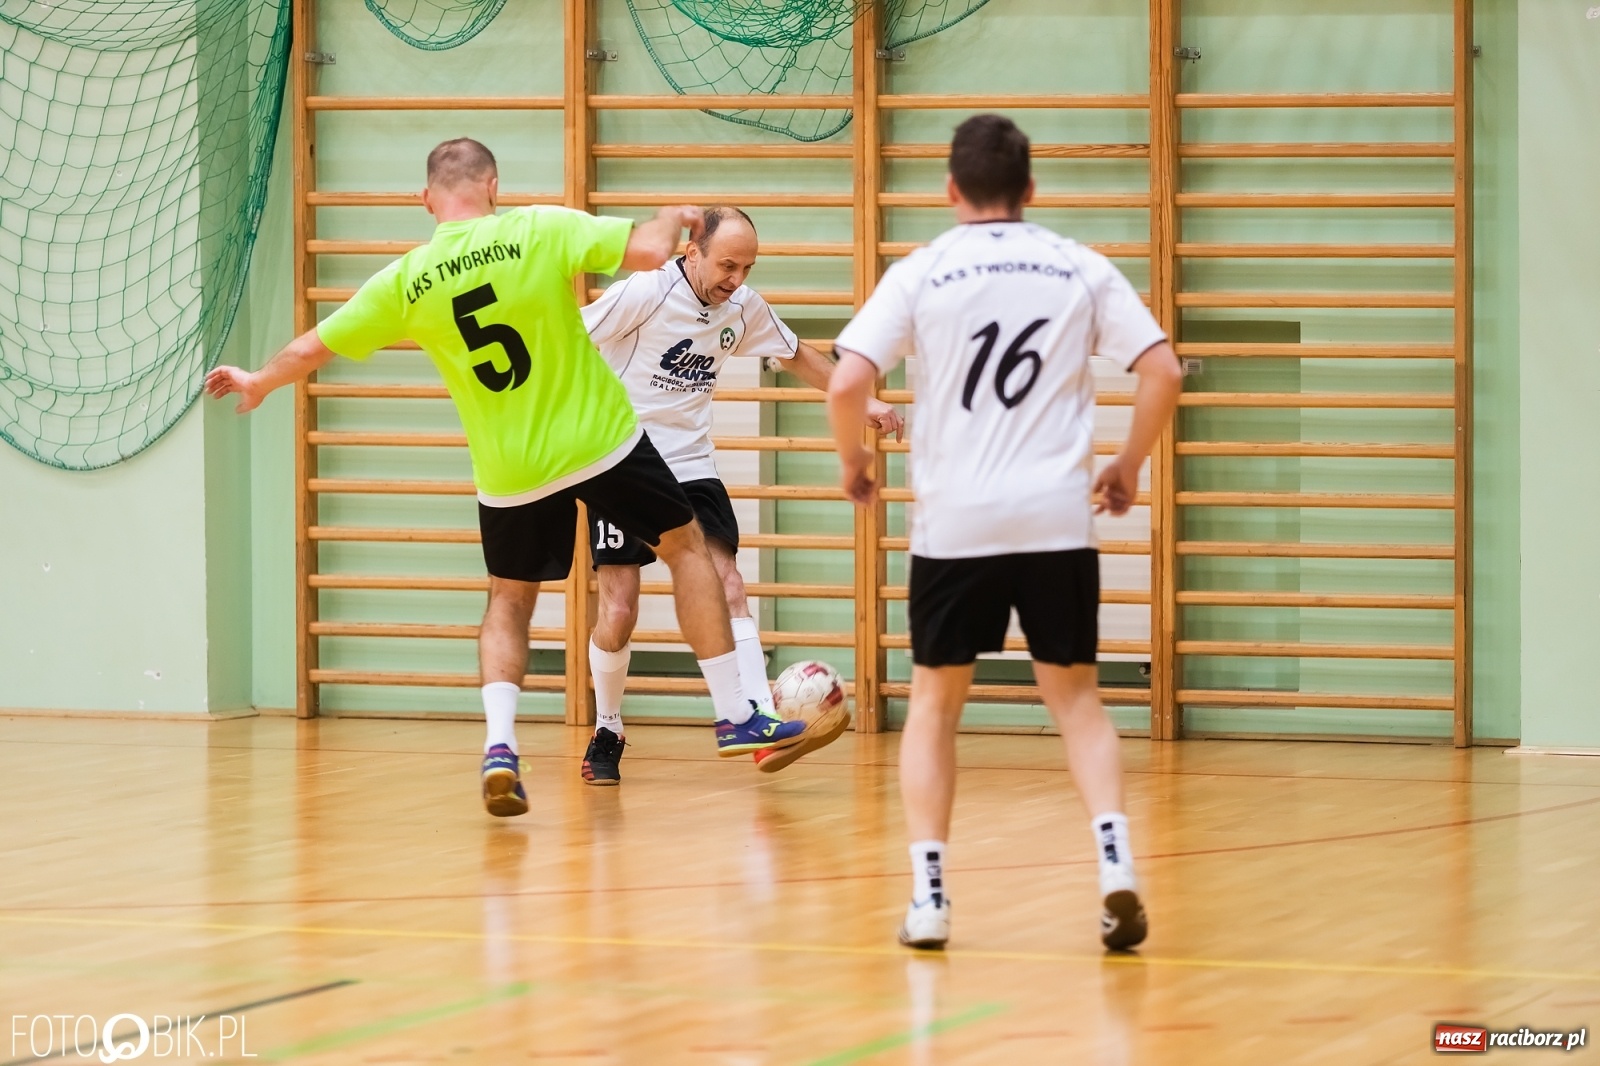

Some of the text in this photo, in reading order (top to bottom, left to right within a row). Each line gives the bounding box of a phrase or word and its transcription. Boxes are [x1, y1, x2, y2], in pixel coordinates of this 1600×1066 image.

[406, 240, 522, 304] LKS TWORKÓW
[931, 269, 967, 288] LKS
[451, 282, 532, 393] 5
[961, 318, 1050, 412] 16
[596, 520, 625, 550] 15
